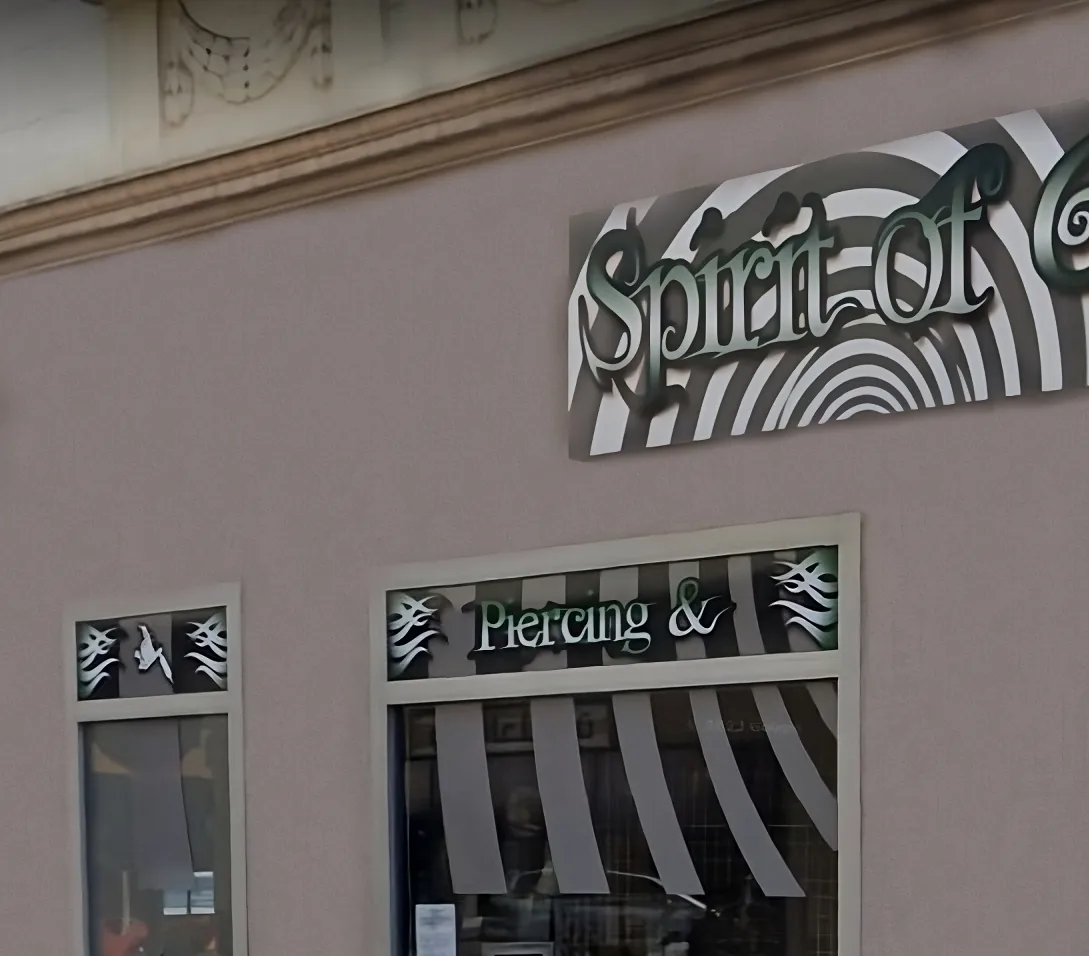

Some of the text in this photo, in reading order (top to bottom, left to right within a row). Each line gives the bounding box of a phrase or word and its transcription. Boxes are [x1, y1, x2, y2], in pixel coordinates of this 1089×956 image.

[580, 195, 862, 408] Spirit
[474, 577, 734, 655] Piercing &
